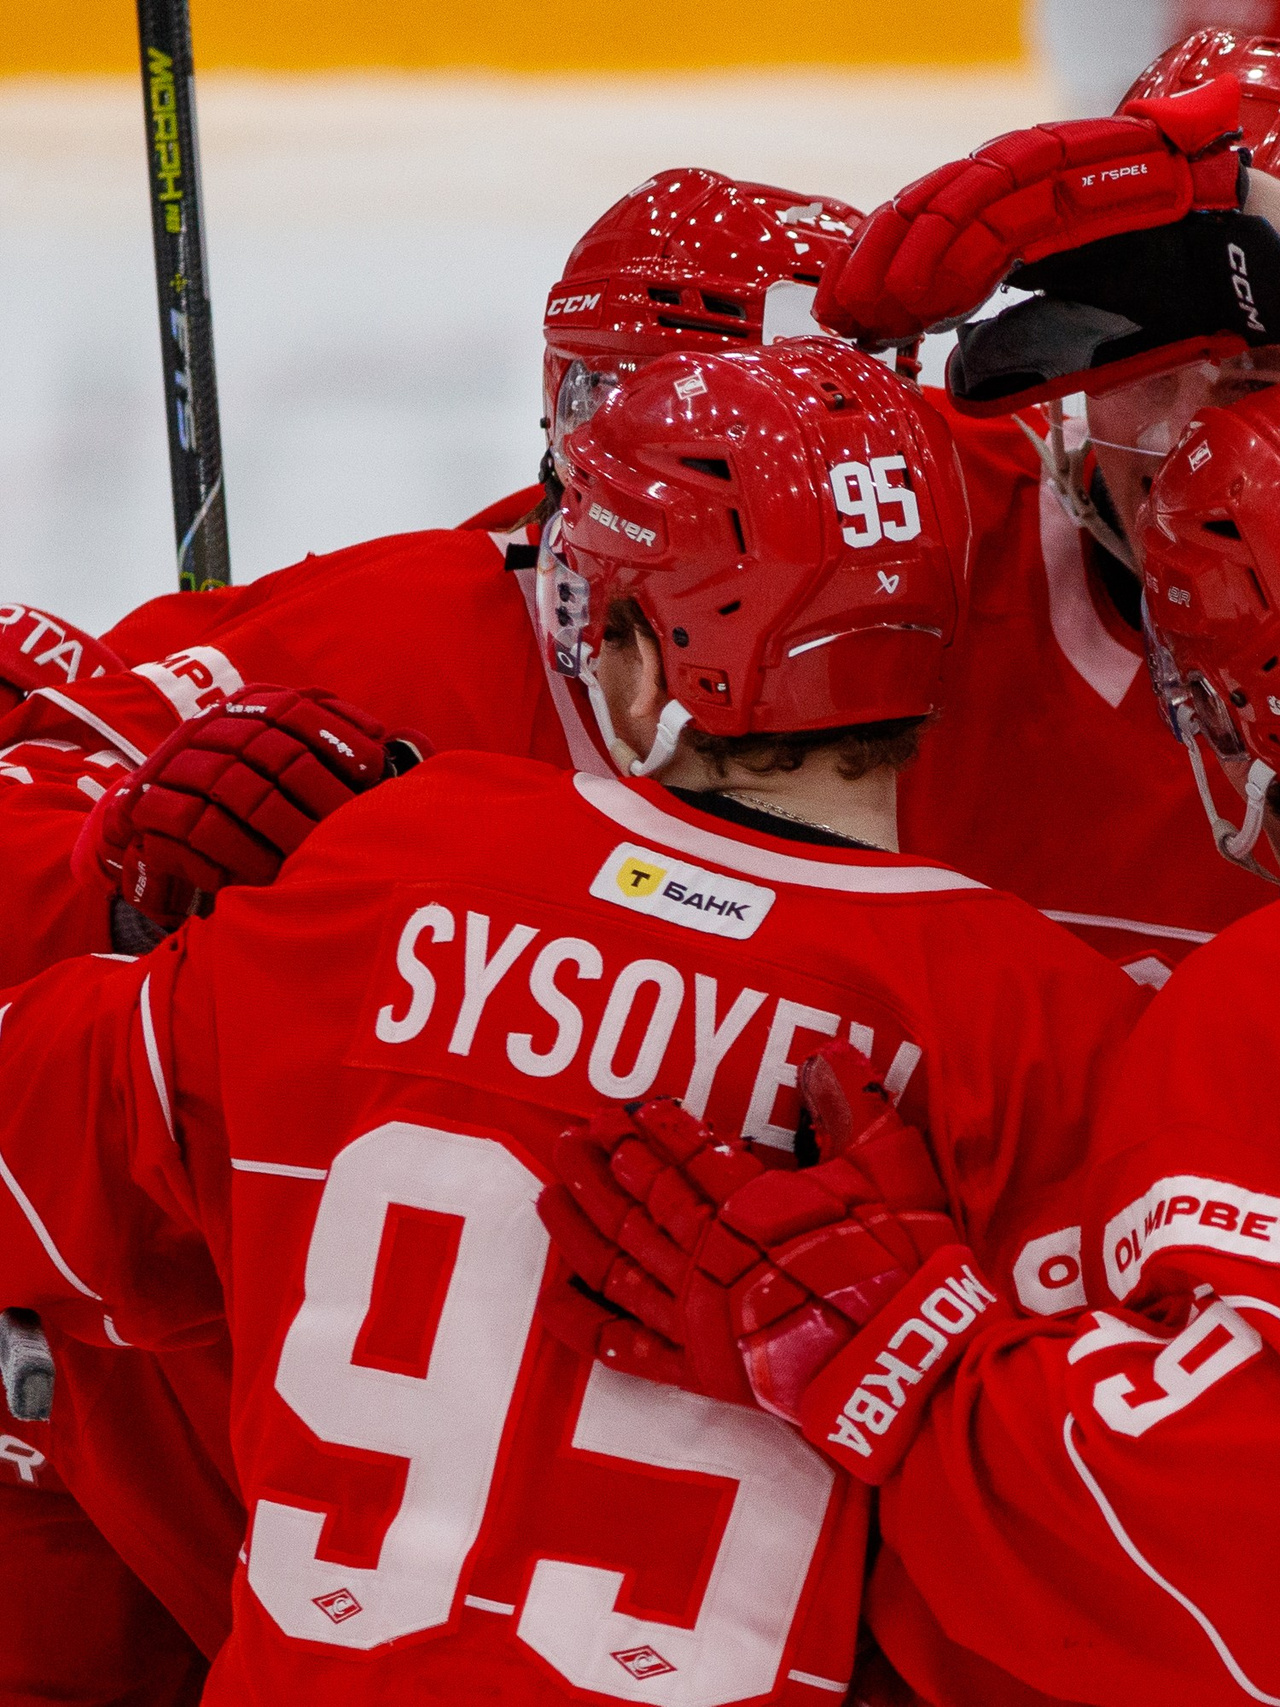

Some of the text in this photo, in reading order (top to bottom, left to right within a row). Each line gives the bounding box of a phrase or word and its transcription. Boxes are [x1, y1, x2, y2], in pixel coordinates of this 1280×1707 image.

[148, 46, 183, 201] MORPH
[548, 292, 600, 316] CCM
[1226, 242, 1266, 334] CCM
[588, 502, 657, 548] BAUER
[829, 455, 922, 549] 95
[662, 881, 751, 921] БАНК
[827, 1265, 997, 1458] МОСКВА
[247, 1121, 836, 1706] 95
